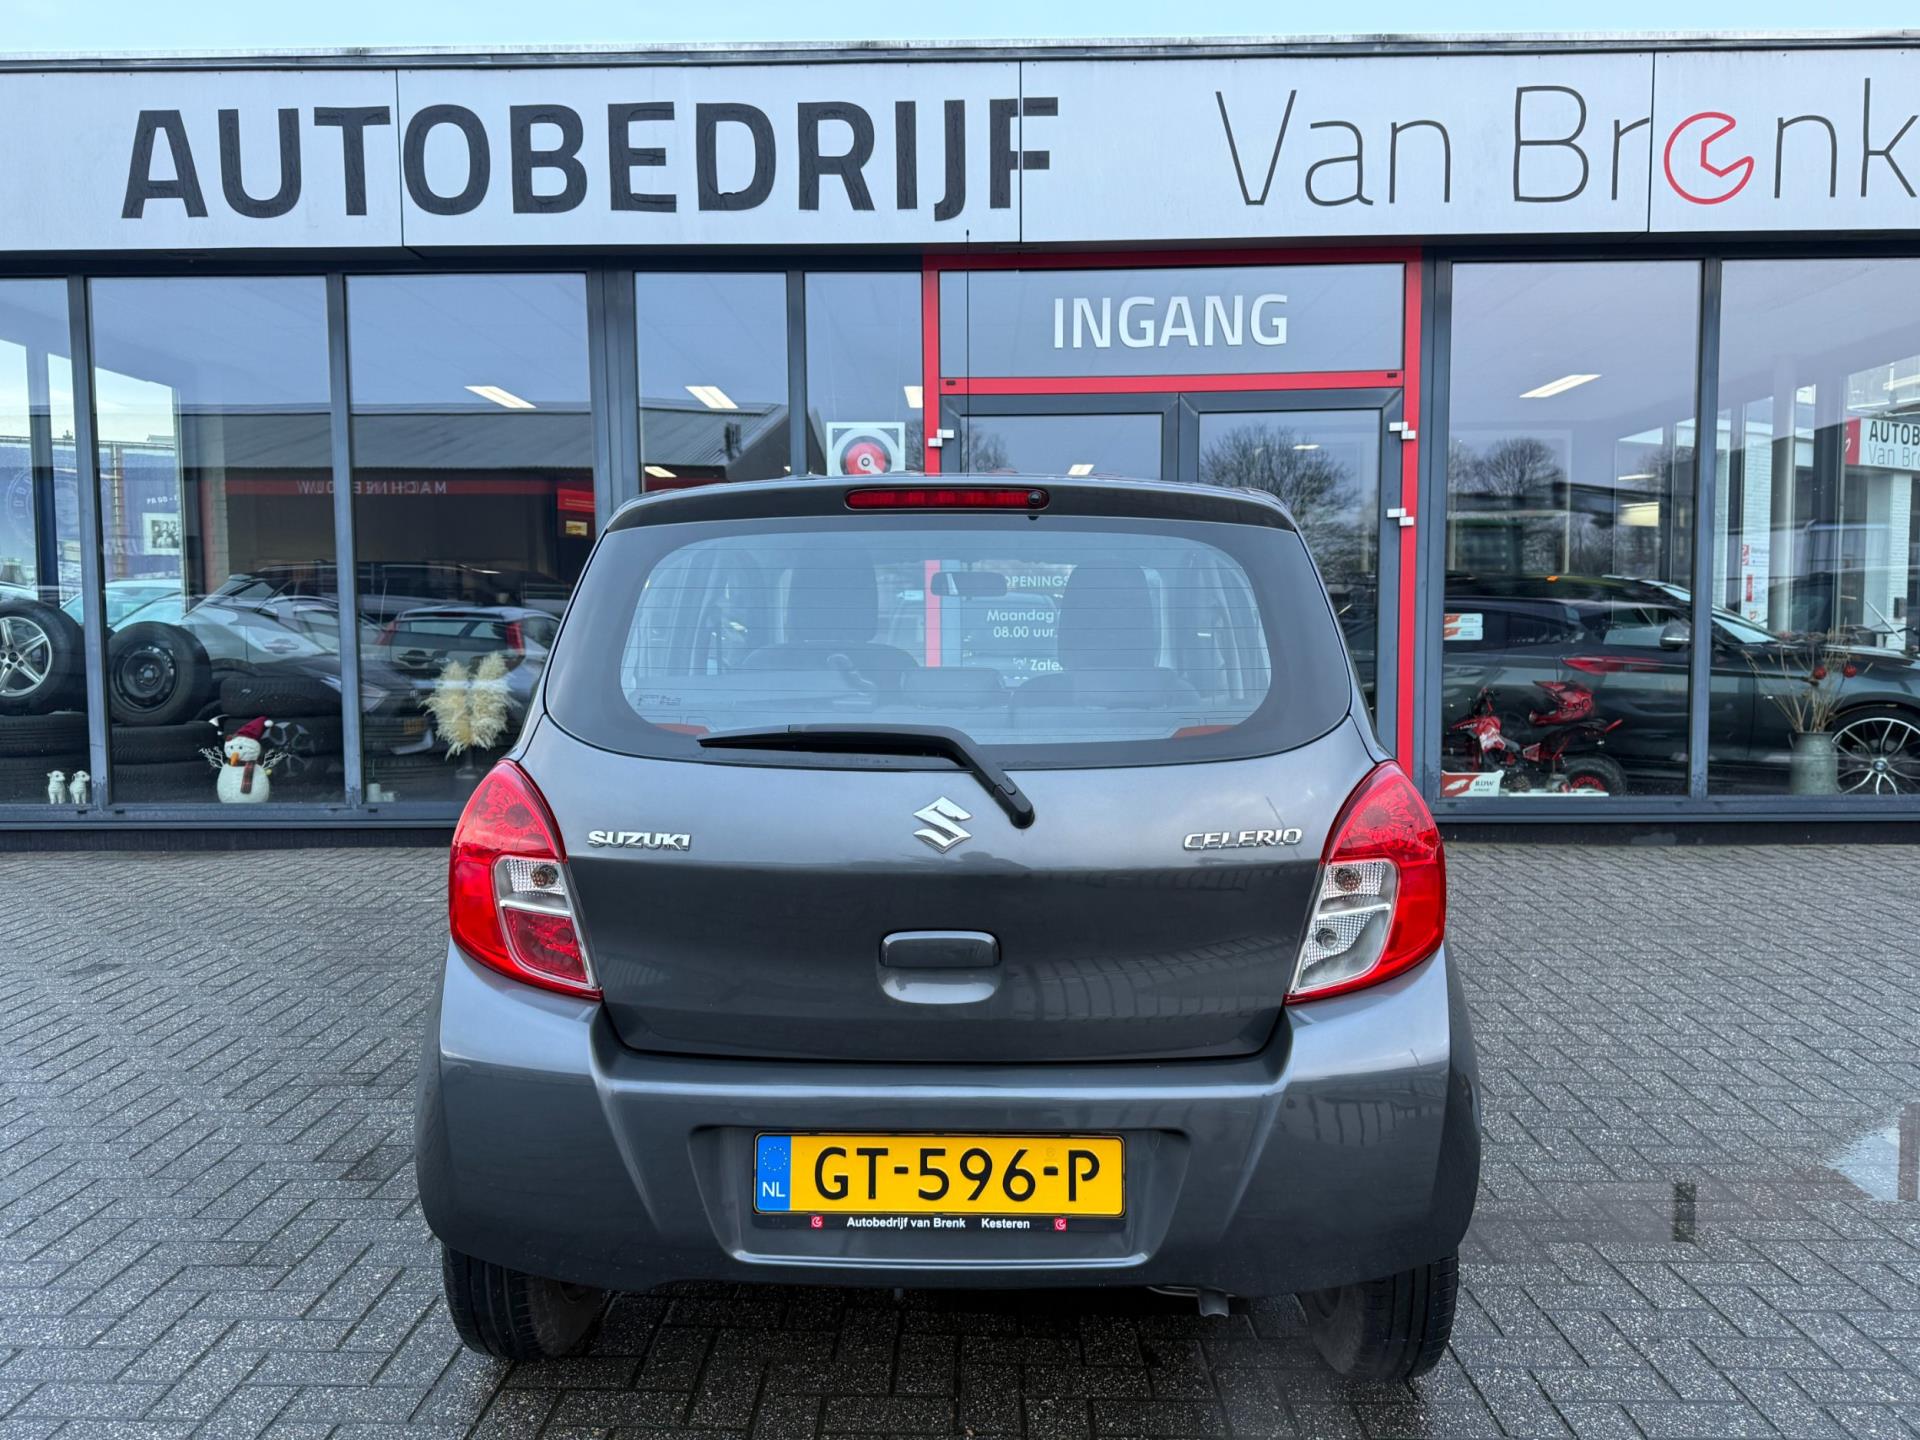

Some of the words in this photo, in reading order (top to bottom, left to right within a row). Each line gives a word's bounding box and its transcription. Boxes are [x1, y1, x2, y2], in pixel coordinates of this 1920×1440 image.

[121, 96, 1059, 222] AUTOBEDRIJF
[1215, 89, 1452, 207] Van
[1512, 77, 1919, 205] Brenk
[1053, 293, 1289, 348] INGANG
[1867, 442, 1896, 465] Van
[1901, 446, 1920, 467] Br
[986, 608, 1055, 624] Maandag
[992, 625, 1030, 639] 08.00
[1029, 658, 1064, 671] Zate
[587, 830, 692, 851] SUZUKI
[1183, 828, 1304, 851] CELERIO
[814, 1146, 1101, 1202] GT-596-P
[761, 1181, 786, 1198] NL
[846, 1216, 908, 1230] Autobedrijf
[910, 1218, 930, 1228] van
[933, 1217, 966, 1229] Brenk
[981, 1217, 1030, 1230] Kesteren
